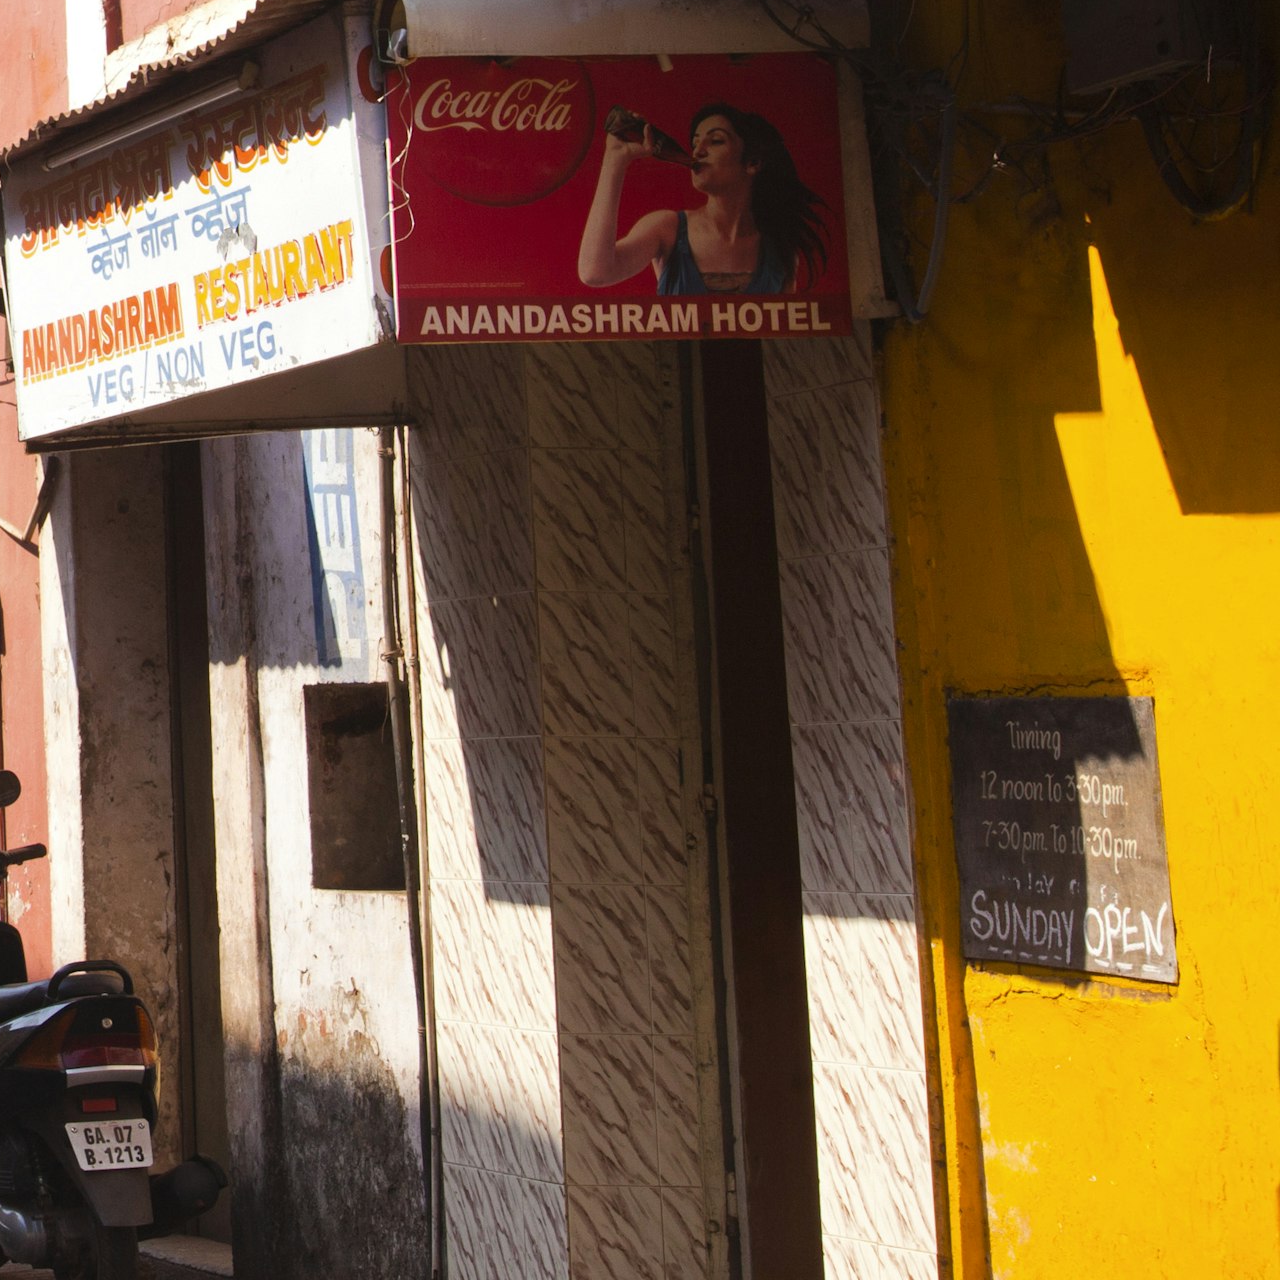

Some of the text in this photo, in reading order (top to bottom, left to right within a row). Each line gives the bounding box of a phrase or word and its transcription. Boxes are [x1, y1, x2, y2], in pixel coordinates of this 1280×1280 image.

[413, 78, 579, 132] Coca-Cola
[22, 217, 356, 386] ANANDASHRAM RESTAURANT
[421, 301, 832, 335] ANANDASHRAM HOTEL
[88, 364, 134, 408] VEG
[157, 341, 207, 386] NON
[1005, 720, 1062, 760] Timing
[981, 771, 998, 800] 12
[1001, 778, 1044, 802] noon
[970, 889, 1075, 964] SUNDAY
[1084, 901, 1169, 960] OPEN
[114, 1125, 132, 1144] 07
